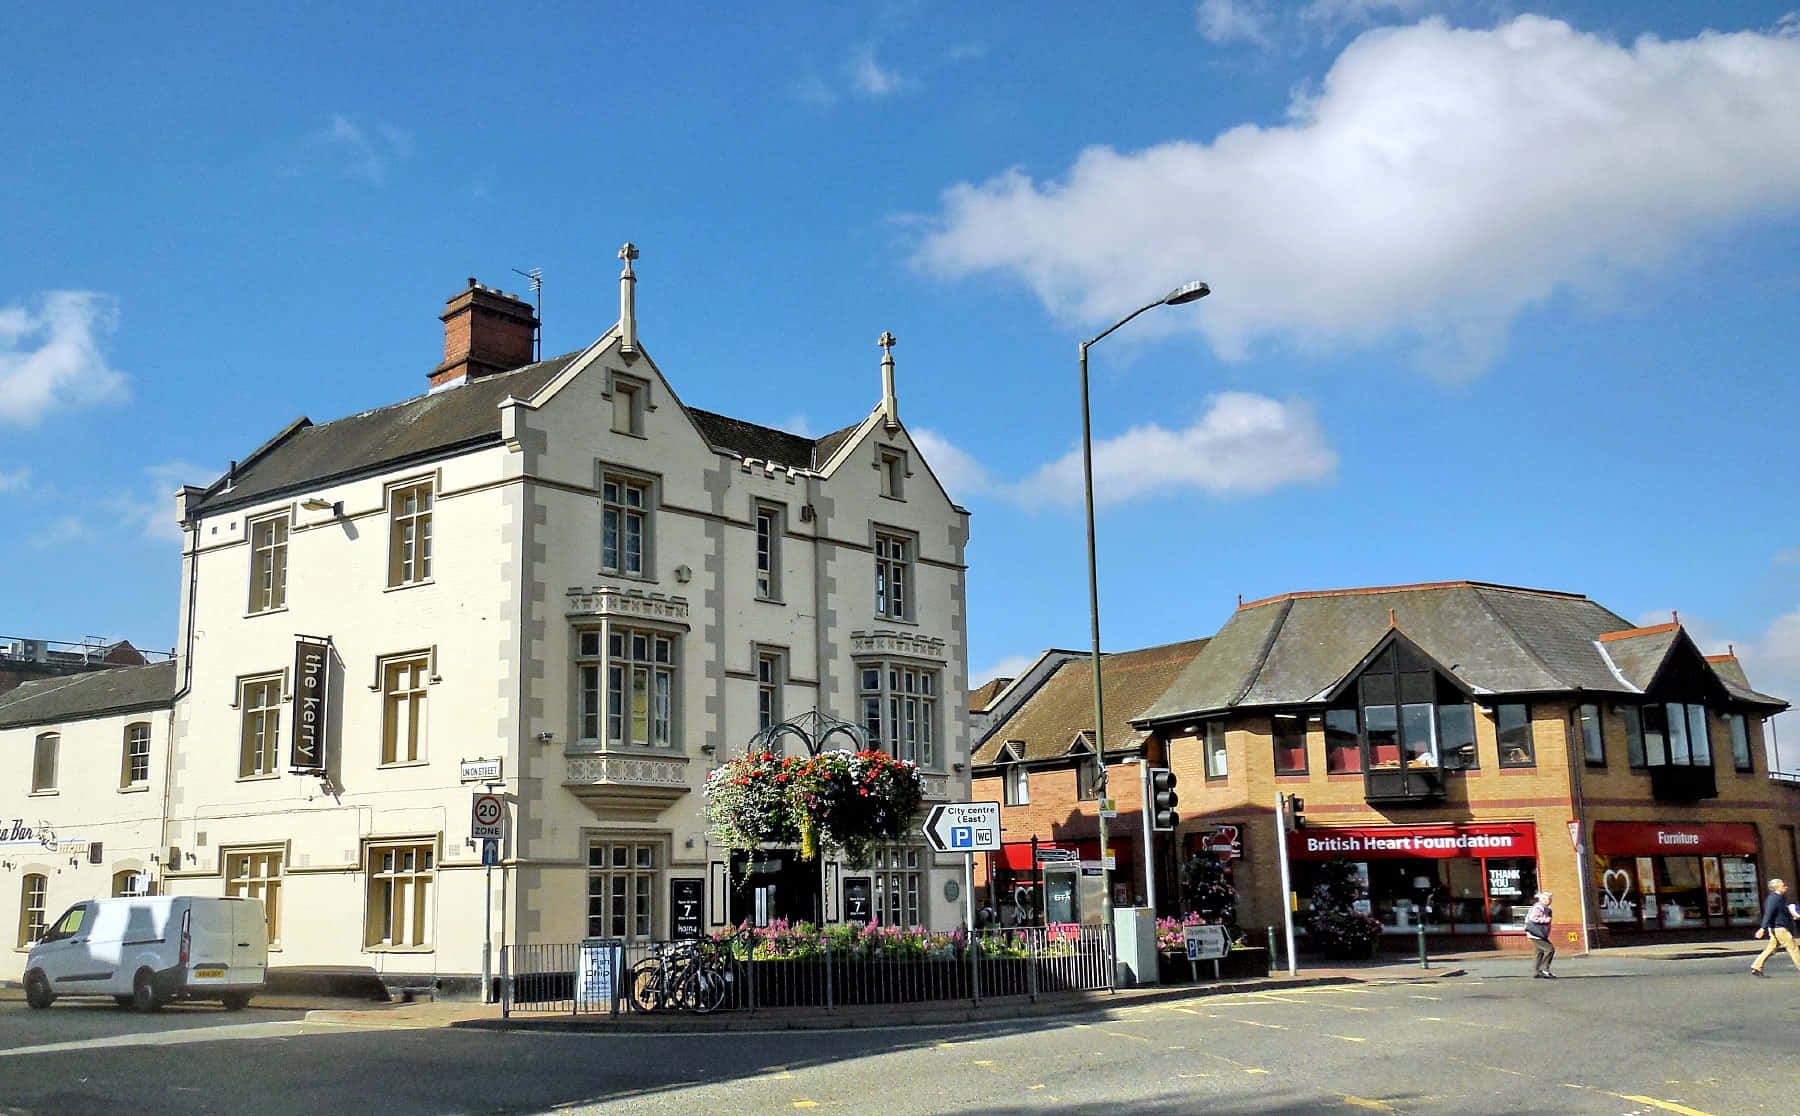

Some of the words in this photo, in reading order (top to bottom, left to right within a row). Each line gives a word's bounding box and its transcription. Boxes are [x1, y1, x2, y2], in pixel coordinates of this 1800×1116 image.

[304, 653, 322, 689] the
[298, 697, 320, 758] kerry
[462, 767, 478, 777] UNION
[478, 766, 497, 776] STREET
[479, 804, 498, 817] 20
[948, 807, 966, 816] City
[967, 807, 996, 815] centre
[957, 815, 987, 824] (East)
[10, 818, 34, 841] Bar
[474, 827, 500, 835] ZONE
[956, 828, 969, 846] P
[977, 832, 990, 842] WC
[1307, 836, 1360, 852] British
[1364, 835, 1411, 851] Heart
[1414, 833, 1513, 850] Foundation
[1658, 831, 1699, 845] Furniture
[1489, 869, 1521, 879] THANK
[1490, 878, 1509, 887] YOU
[684, 904, 692, 917] 7
[855, 901, 861, 913] 7
